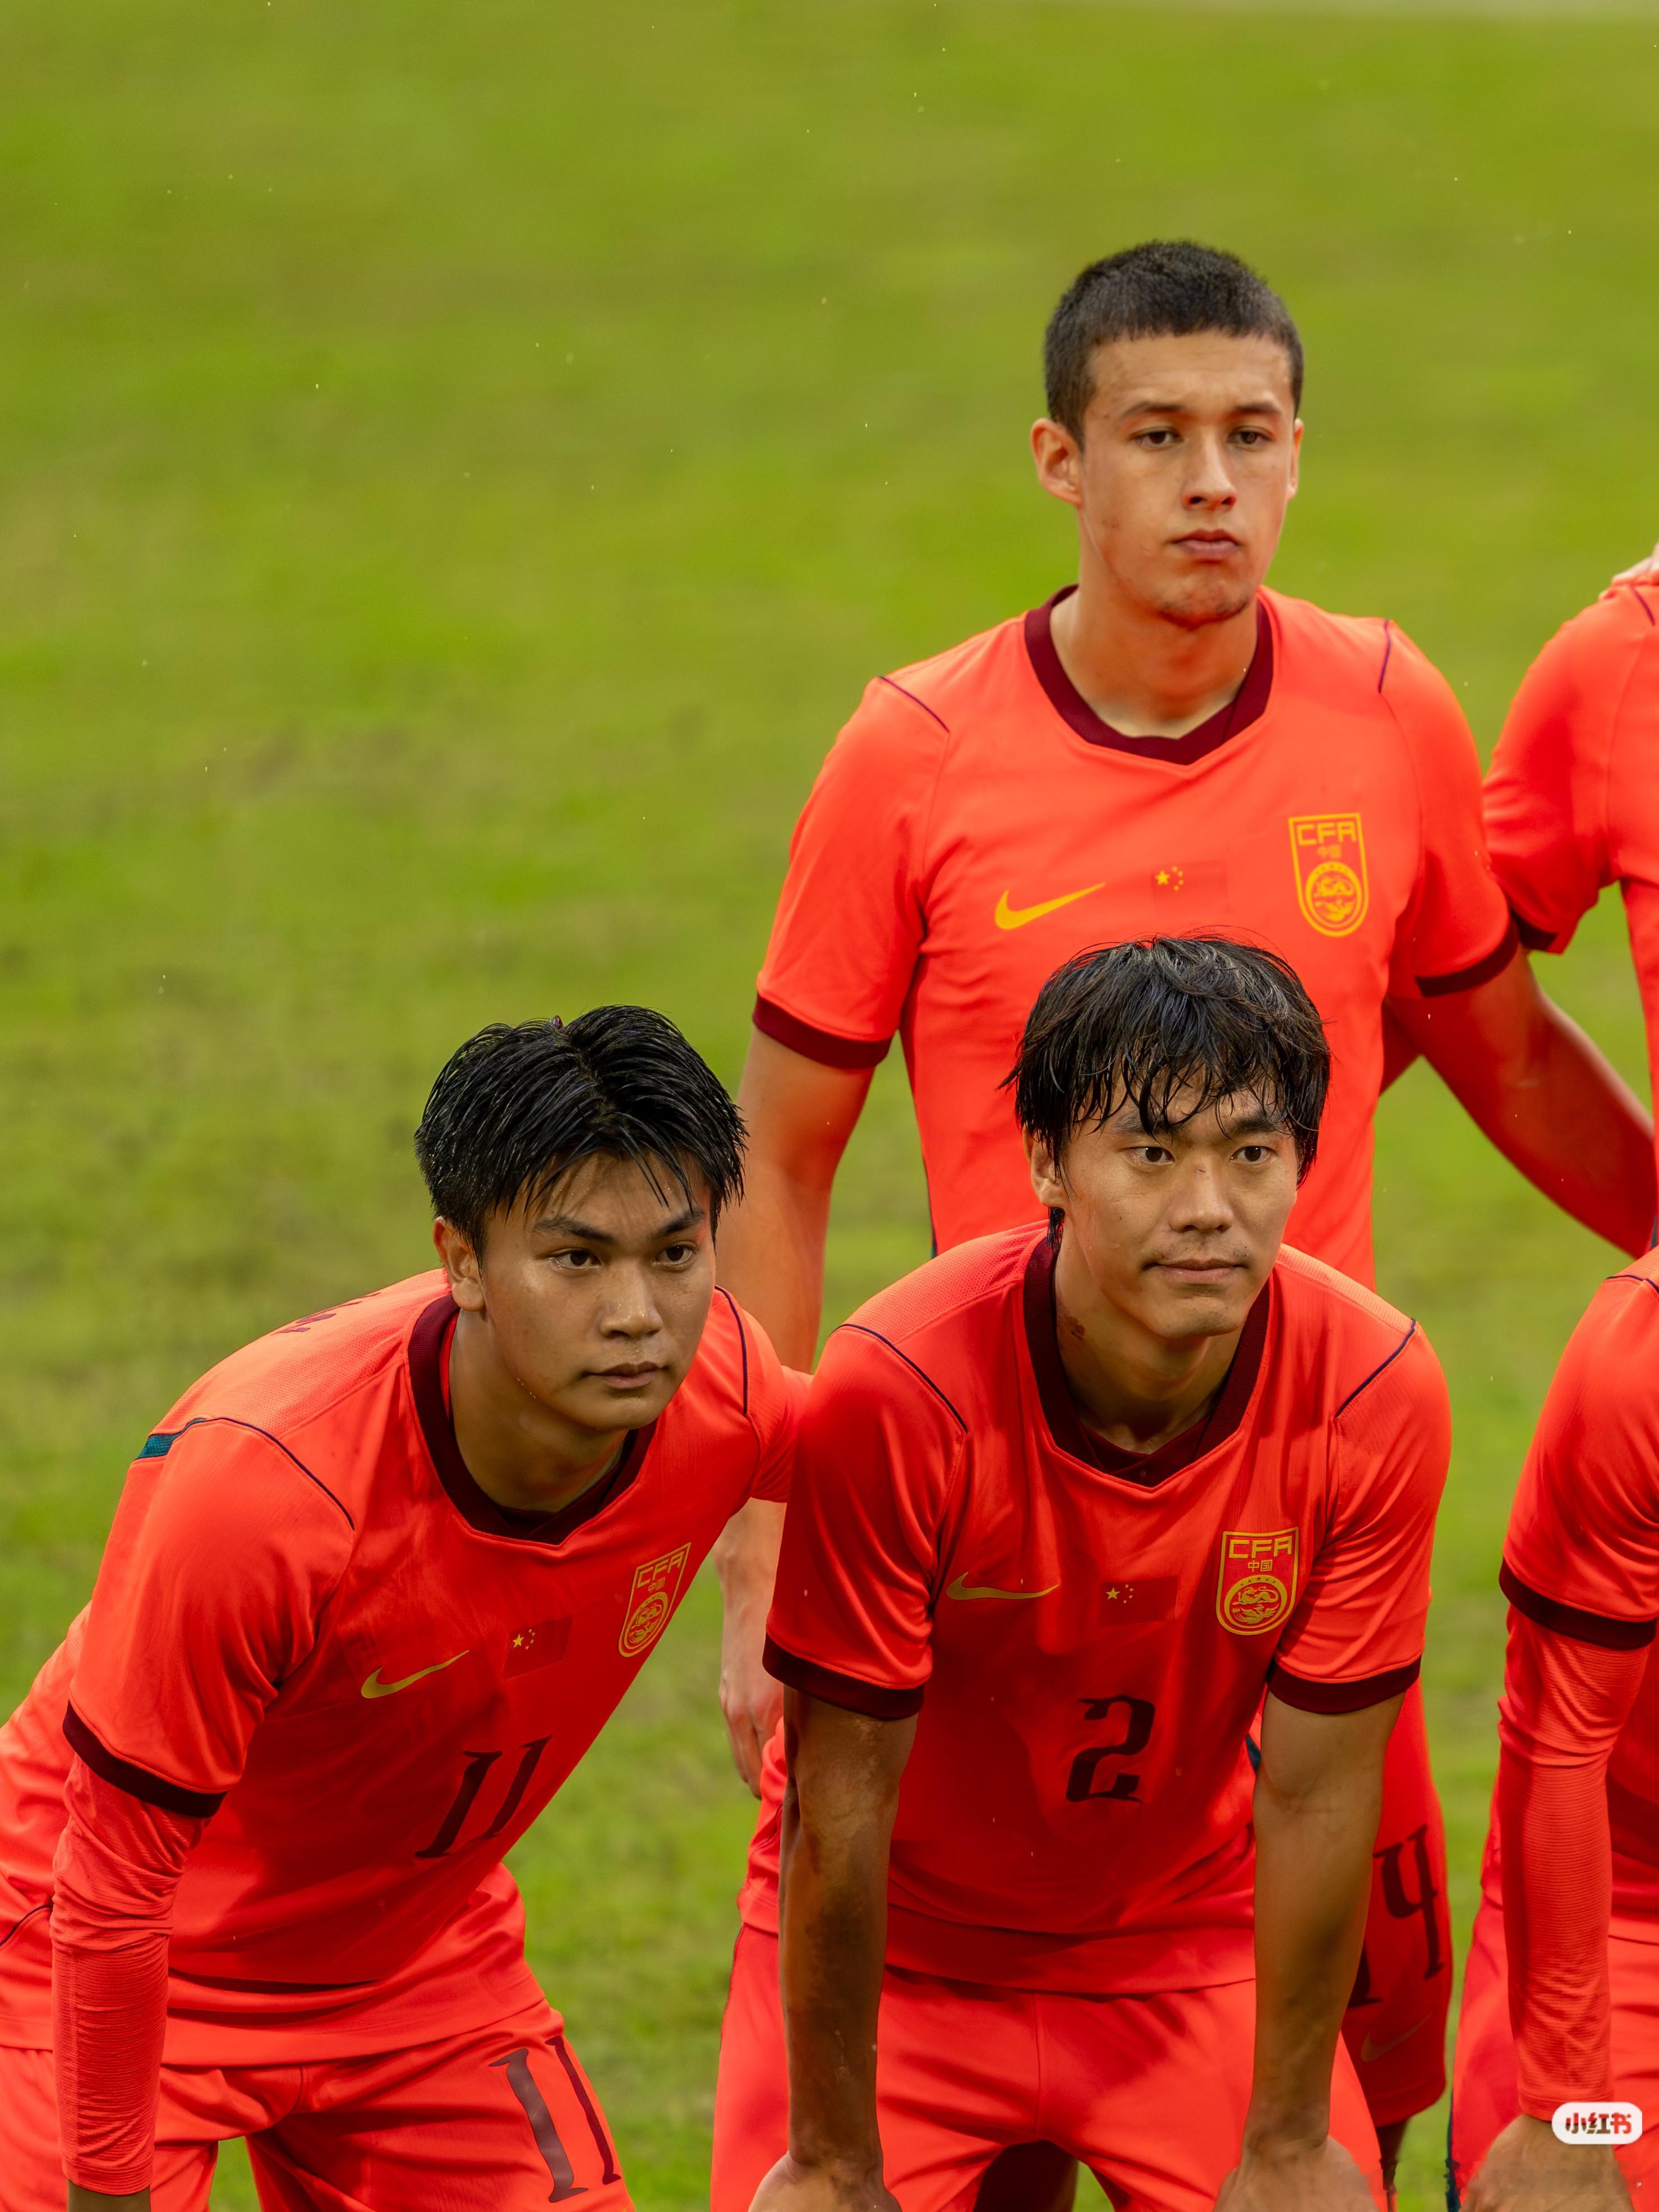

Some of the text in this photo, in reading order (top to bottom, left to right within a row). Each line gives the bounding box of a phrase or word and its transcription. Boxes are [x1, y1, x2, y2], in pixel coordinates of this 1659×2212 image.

[1297, 822, 1357, 845] CFA
[1229, 1536, 1292, 1559] CFA
[637, 1551, 685, 1588] CFA
[1248, 1559, 1273, 1572] 中国
[648, 1577, 666, 1593] 中国
[1066, 1694, 1156, 1803] 2
[414, 1734, 552, 1858] 11
[488, 2035, 621, 2203] 11
